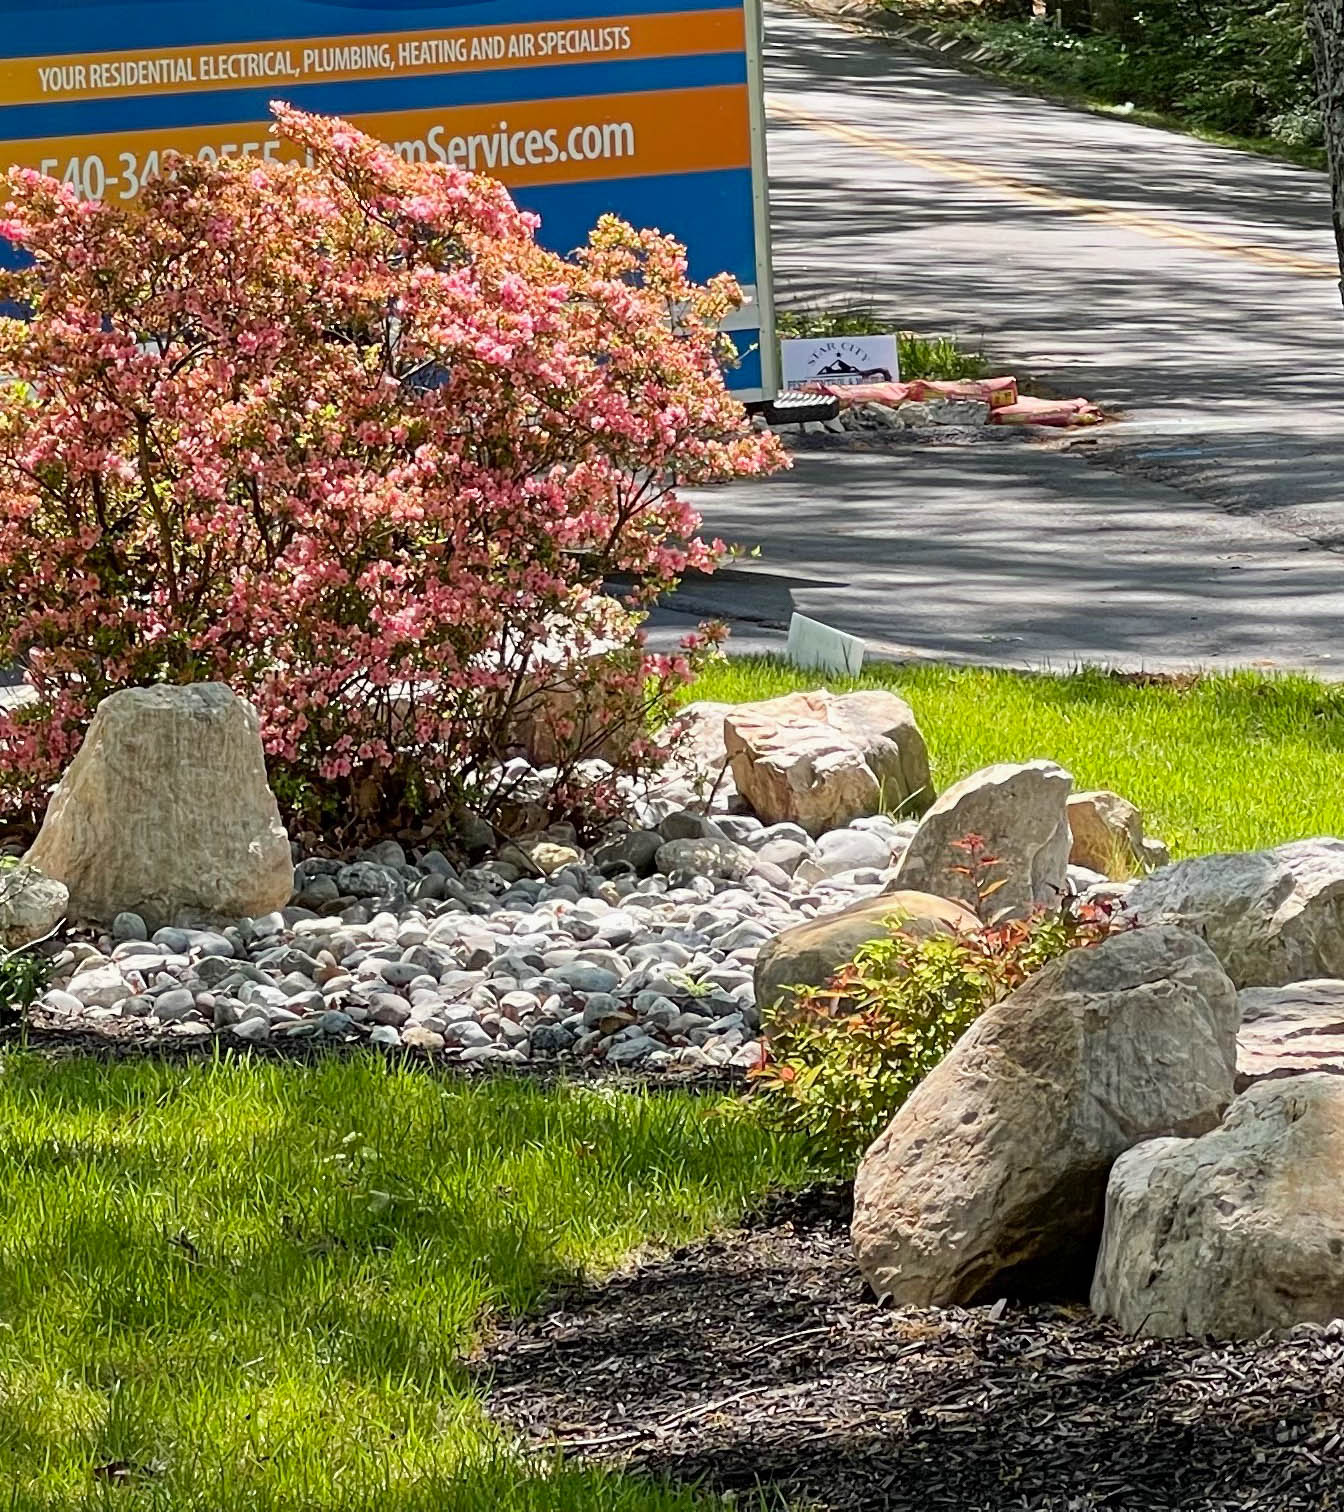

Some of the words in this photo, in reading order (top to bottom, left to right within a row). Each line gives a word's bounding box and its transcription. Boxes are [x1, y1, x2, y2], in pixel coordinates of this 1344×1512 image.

[38, 65, 86, 92] YOUR
[90, 57, 193, 88] RESIDENTIAL
[200, 50, 301, 80] ELECTRICAL,
[304, 43, 395, 73] PLUMBING,
[399, 37, 467, 66] HEATING
[470, 35, 505, 61] AND
[508, 32, 535, 58] AIR
[538, 26, 631, 56] SPECIALISTS
[808, 342, 837, 365] STAR
[841, 342, 870, 362] CITY
